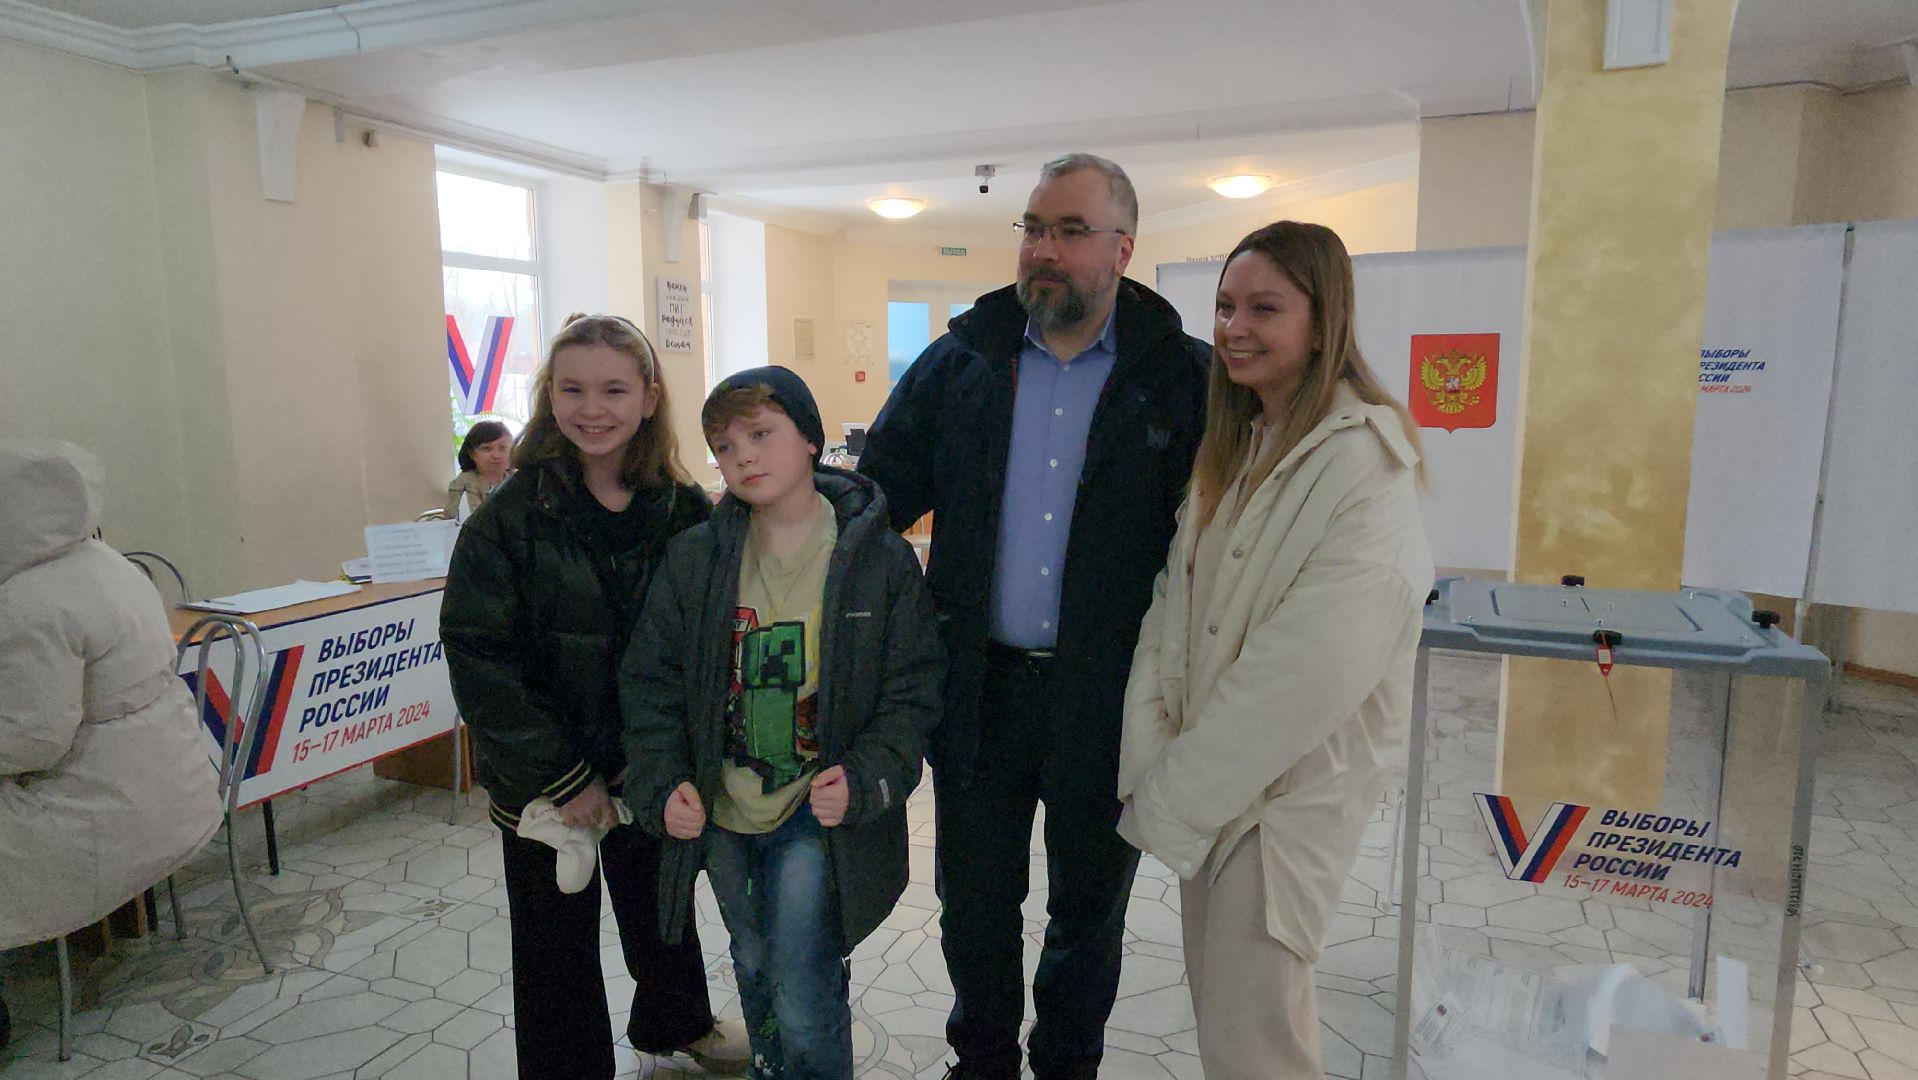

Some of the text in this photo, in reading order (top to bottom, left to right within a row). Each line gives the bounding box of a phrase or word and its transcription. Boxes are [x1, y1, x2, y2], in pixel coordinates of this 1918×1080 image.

[1698, 373, 1730, 382] ССИИ
[1700, 362, 1766, 371] РЕЗИДЕНТА
[317, 618, 415, 663] ВЫБОРЫ
[308, 640, 443, 698] ПРЕЗИДЕНТА
[299, 684, 390, 733] РОССИИ
[341, 712, 393, 747] МАРТА
[396, 701, 430, 728] 2024
[1600, 809, 1711, 838] ВЫБОРЫ
[1586, 831, 1742, 868] ПРЕЗИДЕНТА
[1573, 853, 1671, 881] РОССИИ
[1611, 880, 1669, 901] МАРТА
[1672, 890, 1715, 908] 2024
